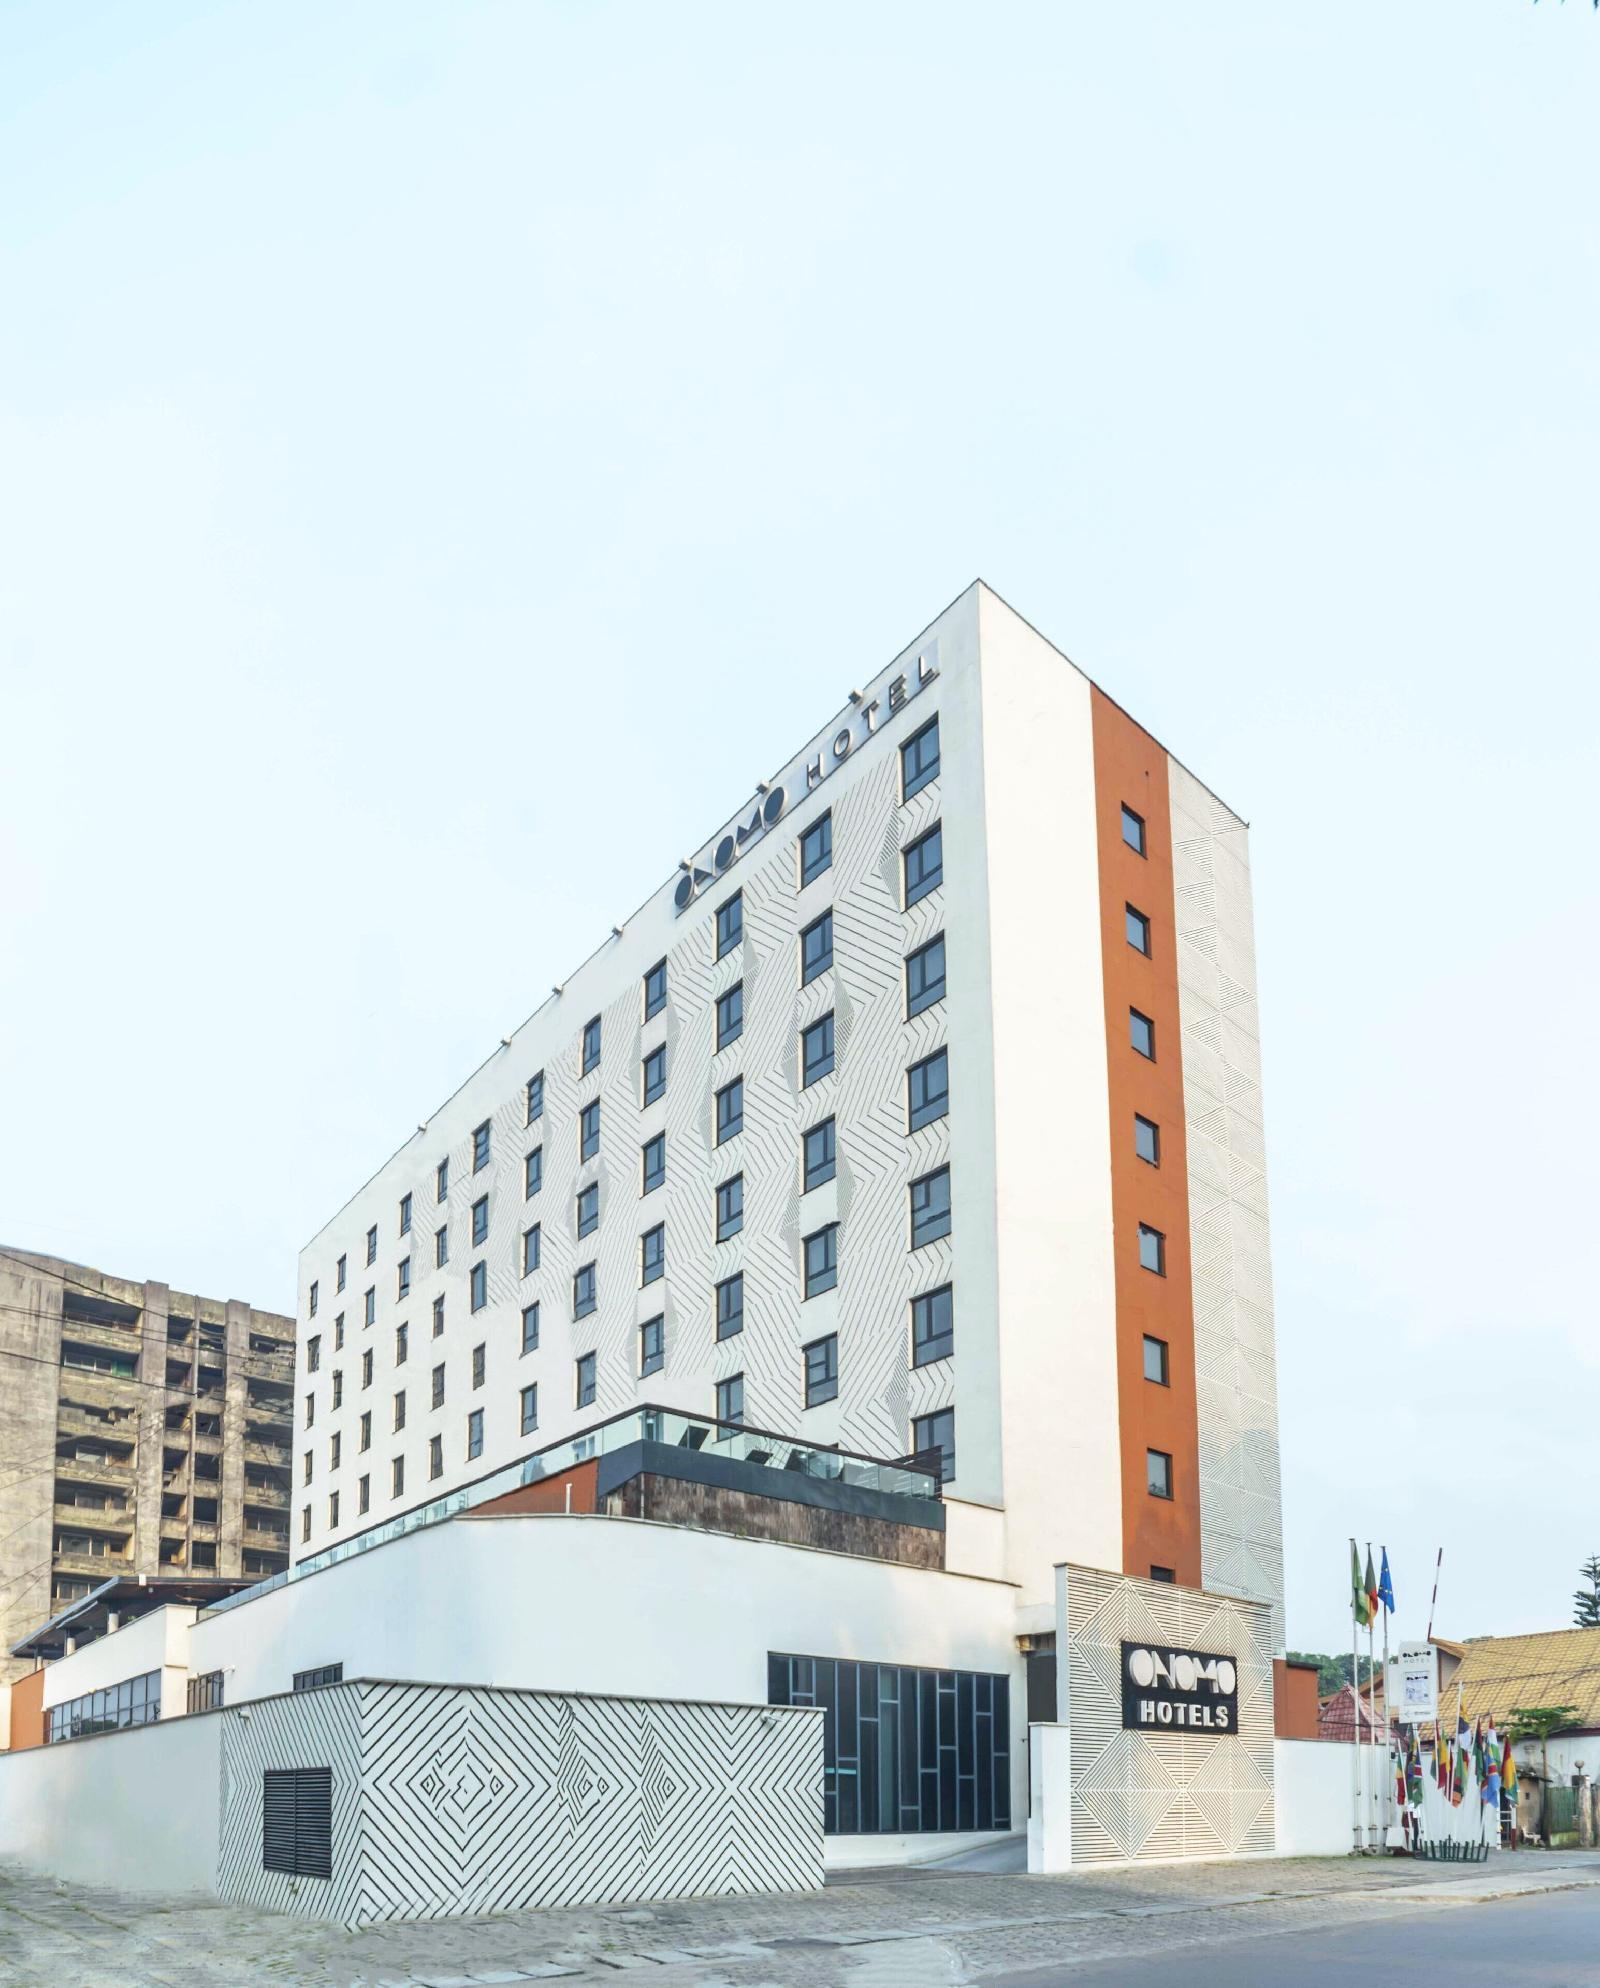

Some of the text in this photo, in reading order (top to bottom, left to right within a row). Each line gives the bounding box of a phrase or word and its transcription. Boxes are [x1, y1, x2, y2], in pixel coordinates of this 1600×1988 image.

[674, 656, 941, 909] ONOMO HOTEL
[1129, 1649, 1235, 1695] ONOMO
[1139, 1700, 1229, 1728] HOTELS
